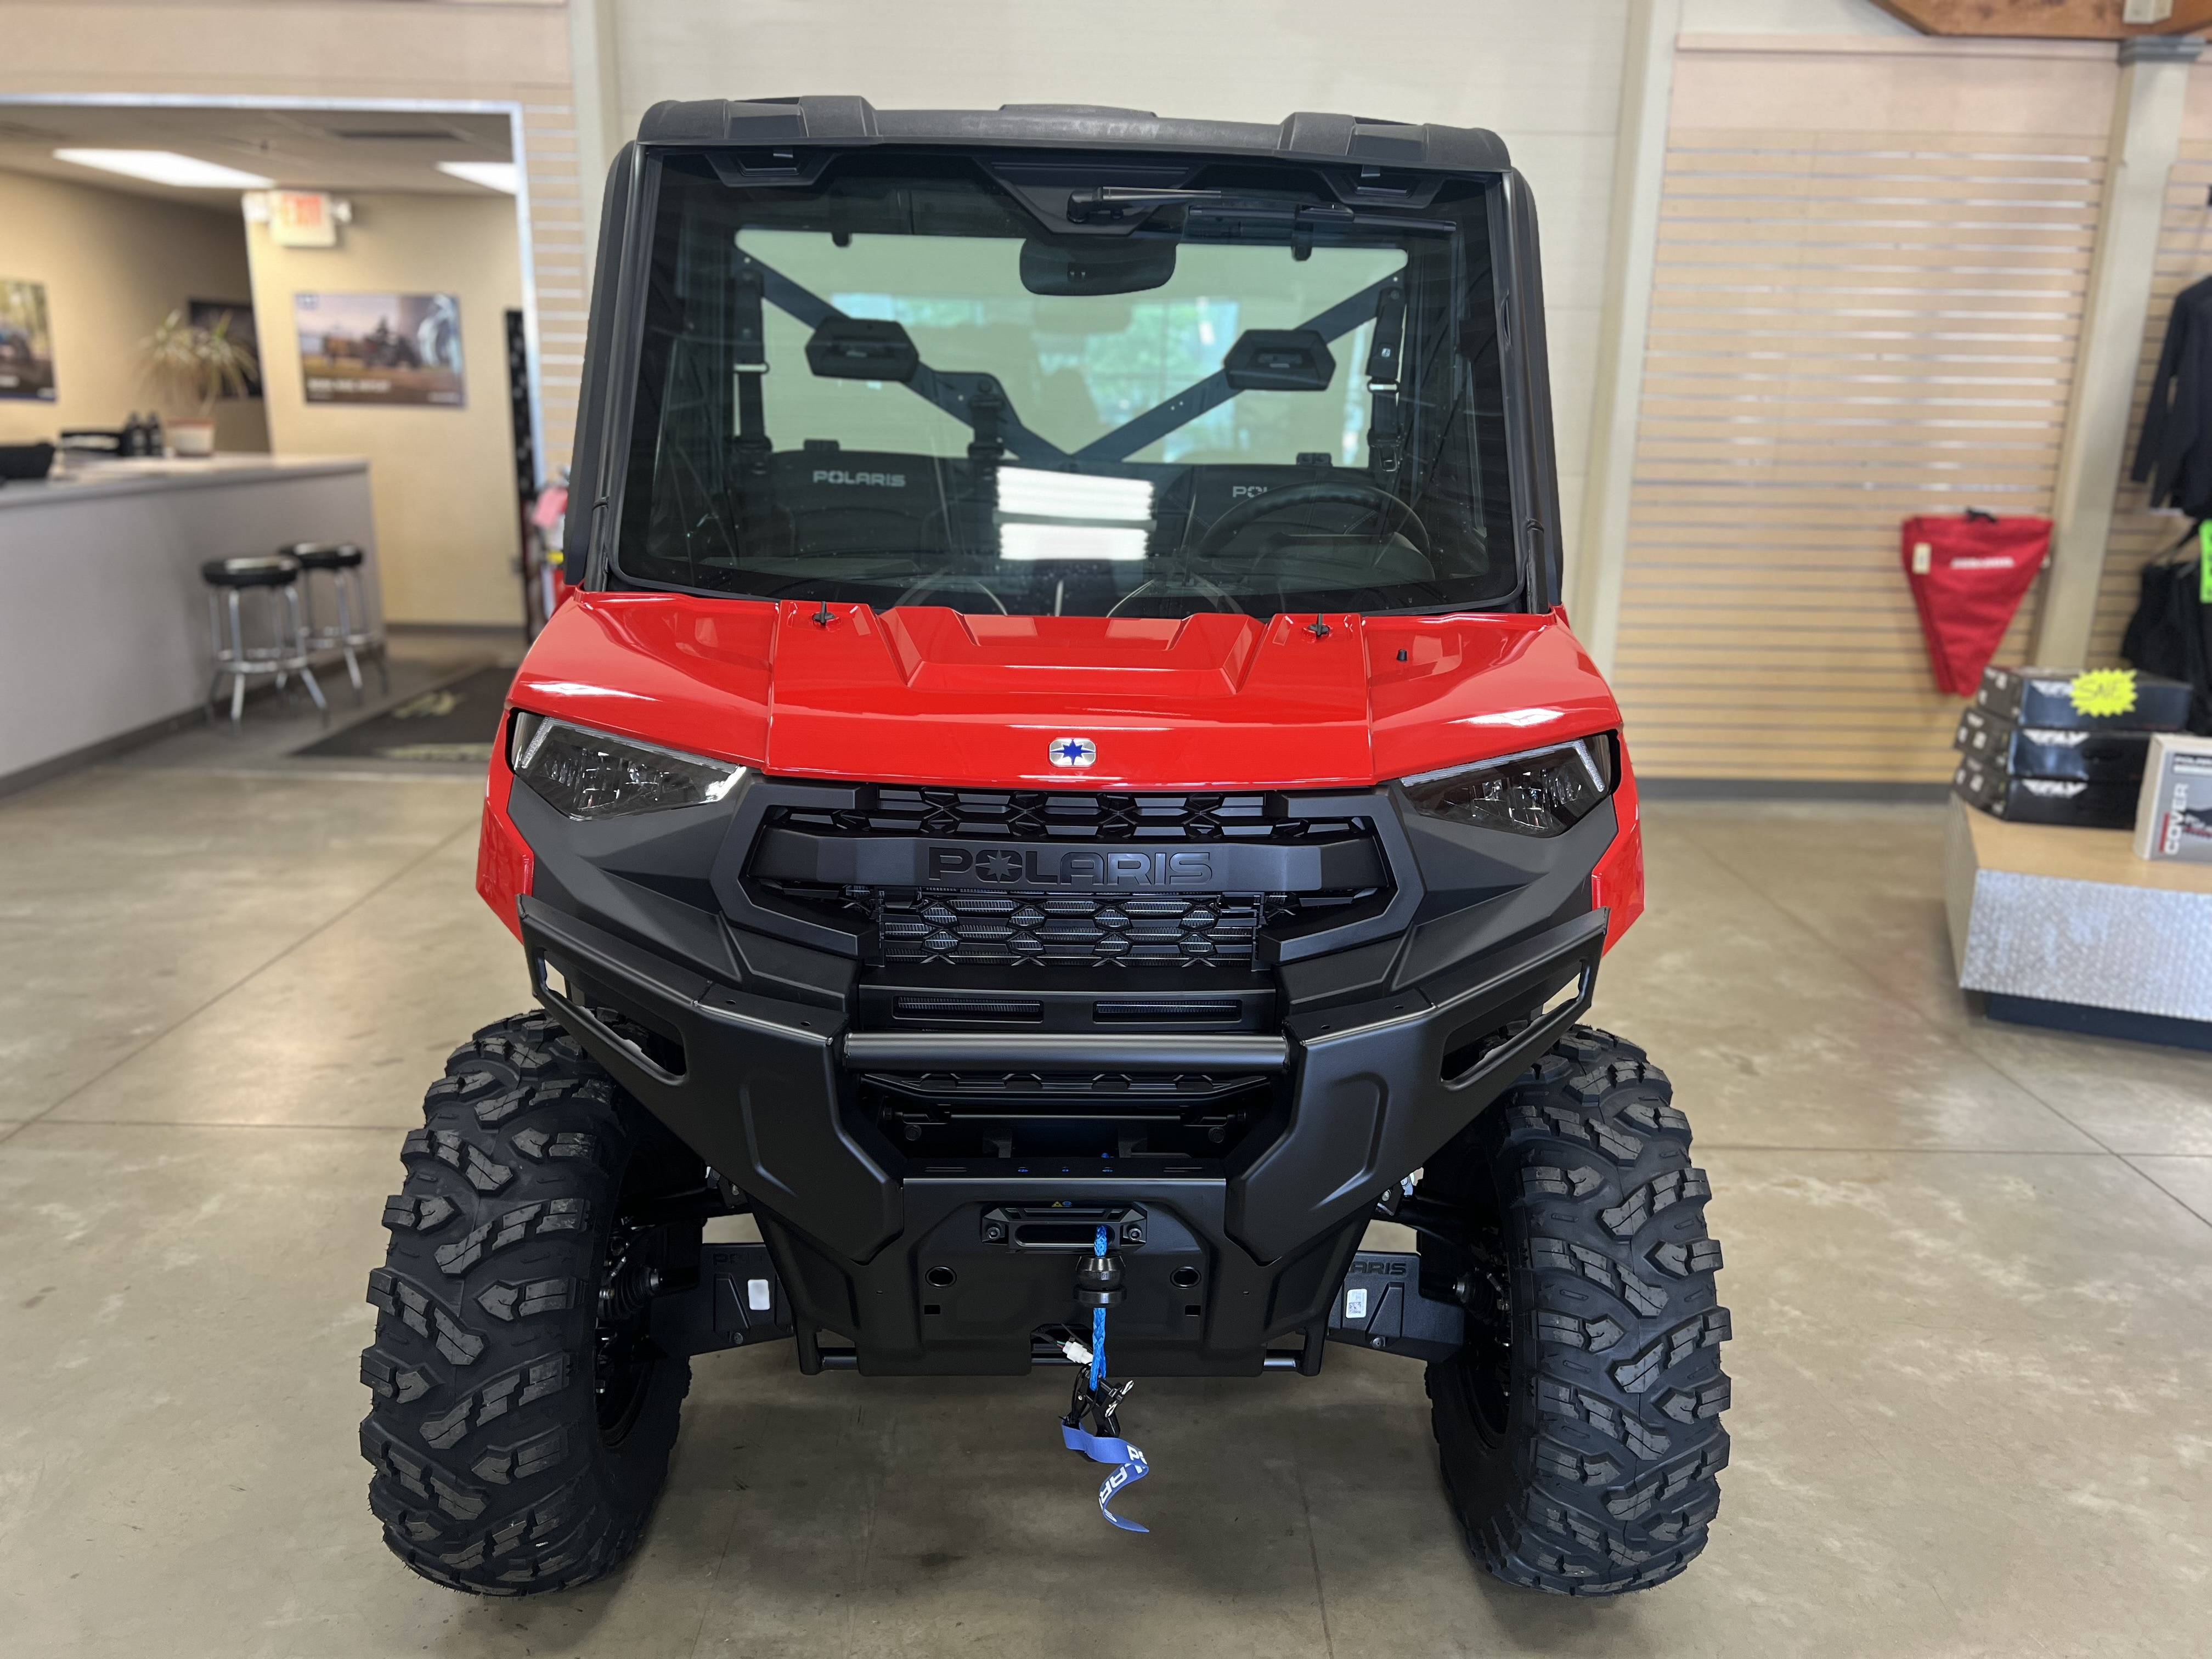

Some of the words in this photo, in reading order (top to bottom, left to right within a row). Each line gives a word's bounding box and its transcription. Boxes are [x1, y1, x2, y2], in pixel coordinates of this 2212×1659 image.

[812, 470, 906, 487] POLARIS
[2164, 783, 2190, 855] COVER
[928, 847, 1213, 885] POLARIS
